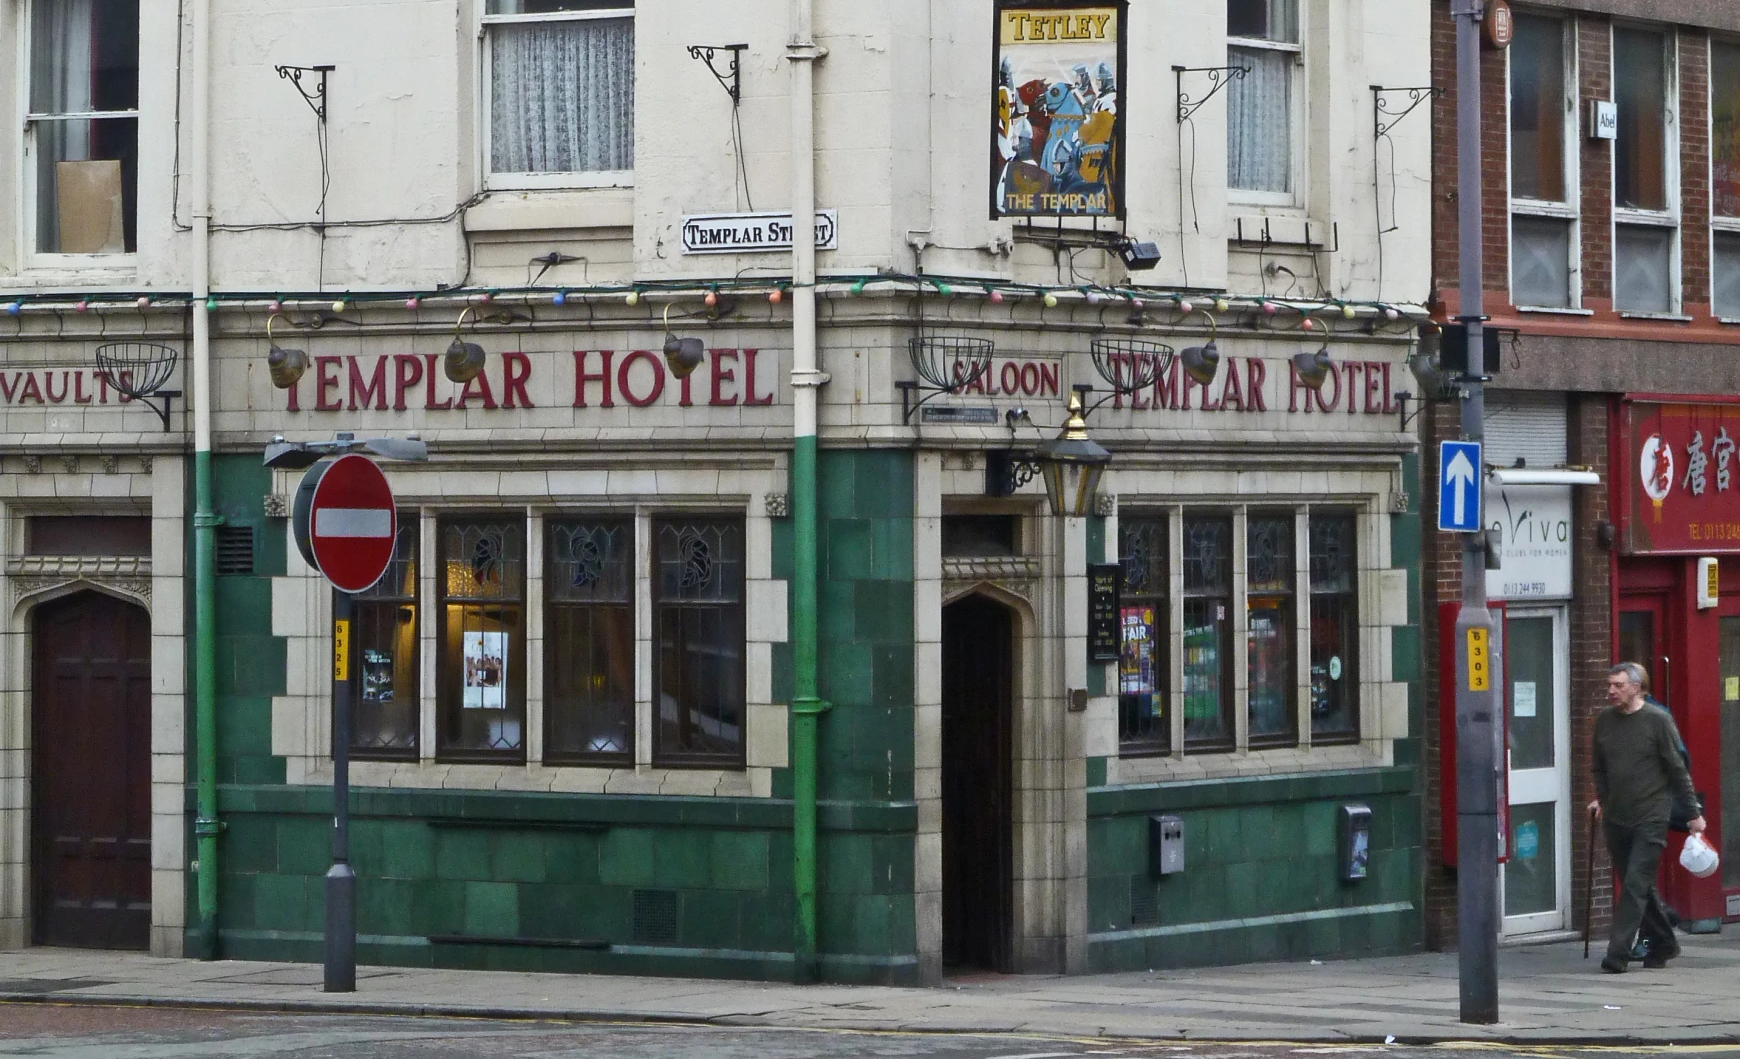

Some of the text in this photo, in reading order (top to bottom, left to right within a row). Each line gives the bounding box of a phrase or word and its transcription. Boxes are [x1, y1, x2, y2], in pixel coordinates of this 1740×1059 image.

[1008, 12, 1110, 41] TETLEY
[1600, 113, 1616, 128] Abel
[1006, 193, 1107, 210] THE TEMPLAR
[688, 222, 828, 245] TEMPLAR STT
[0, 371, 134, 404] VAULTS
[952, 360, 1059, 397] SALOON
[1109, 352, 1400, 414] TEMPLAR HOTEL
[1492, 490, 1567, 544] Viva
[1122, 625, 1147, 642] FAIR
[335, 625, 343, 676] 6325
[1473, 631, 1483, 687] 6303
